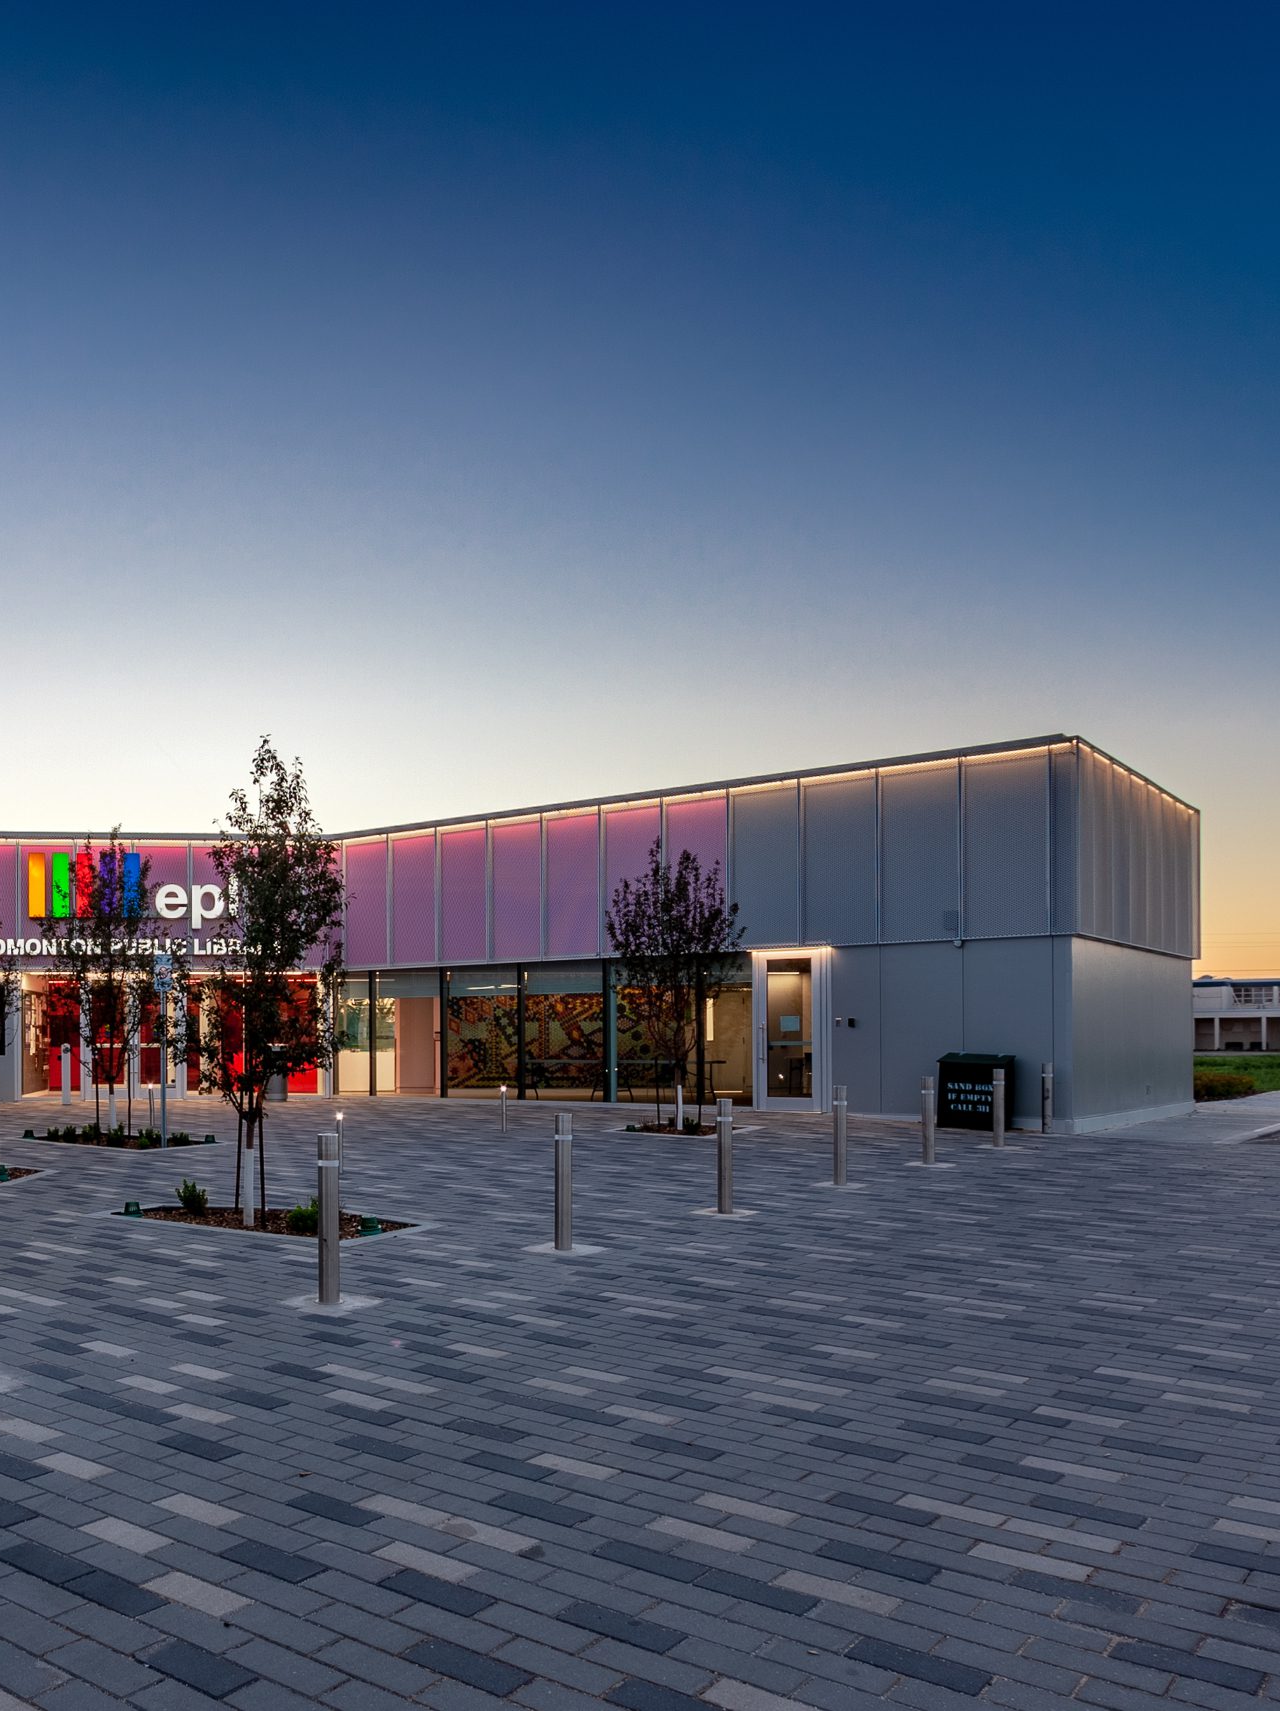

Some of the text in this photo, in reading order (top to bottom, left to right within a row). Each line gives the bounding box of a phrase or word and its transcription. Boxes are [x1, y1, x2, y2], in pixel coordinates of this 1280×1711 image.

[155, 873, 239, 929] epl
[110, 938, 187, 956] PUBLIC
[194, 938, 281, 956] LIBRA
[947, 1082, 972, 1090] SAND
[948, 1092, 992, 1102] IF EMPTY
[950, 1103, 972, 1111] CALL
